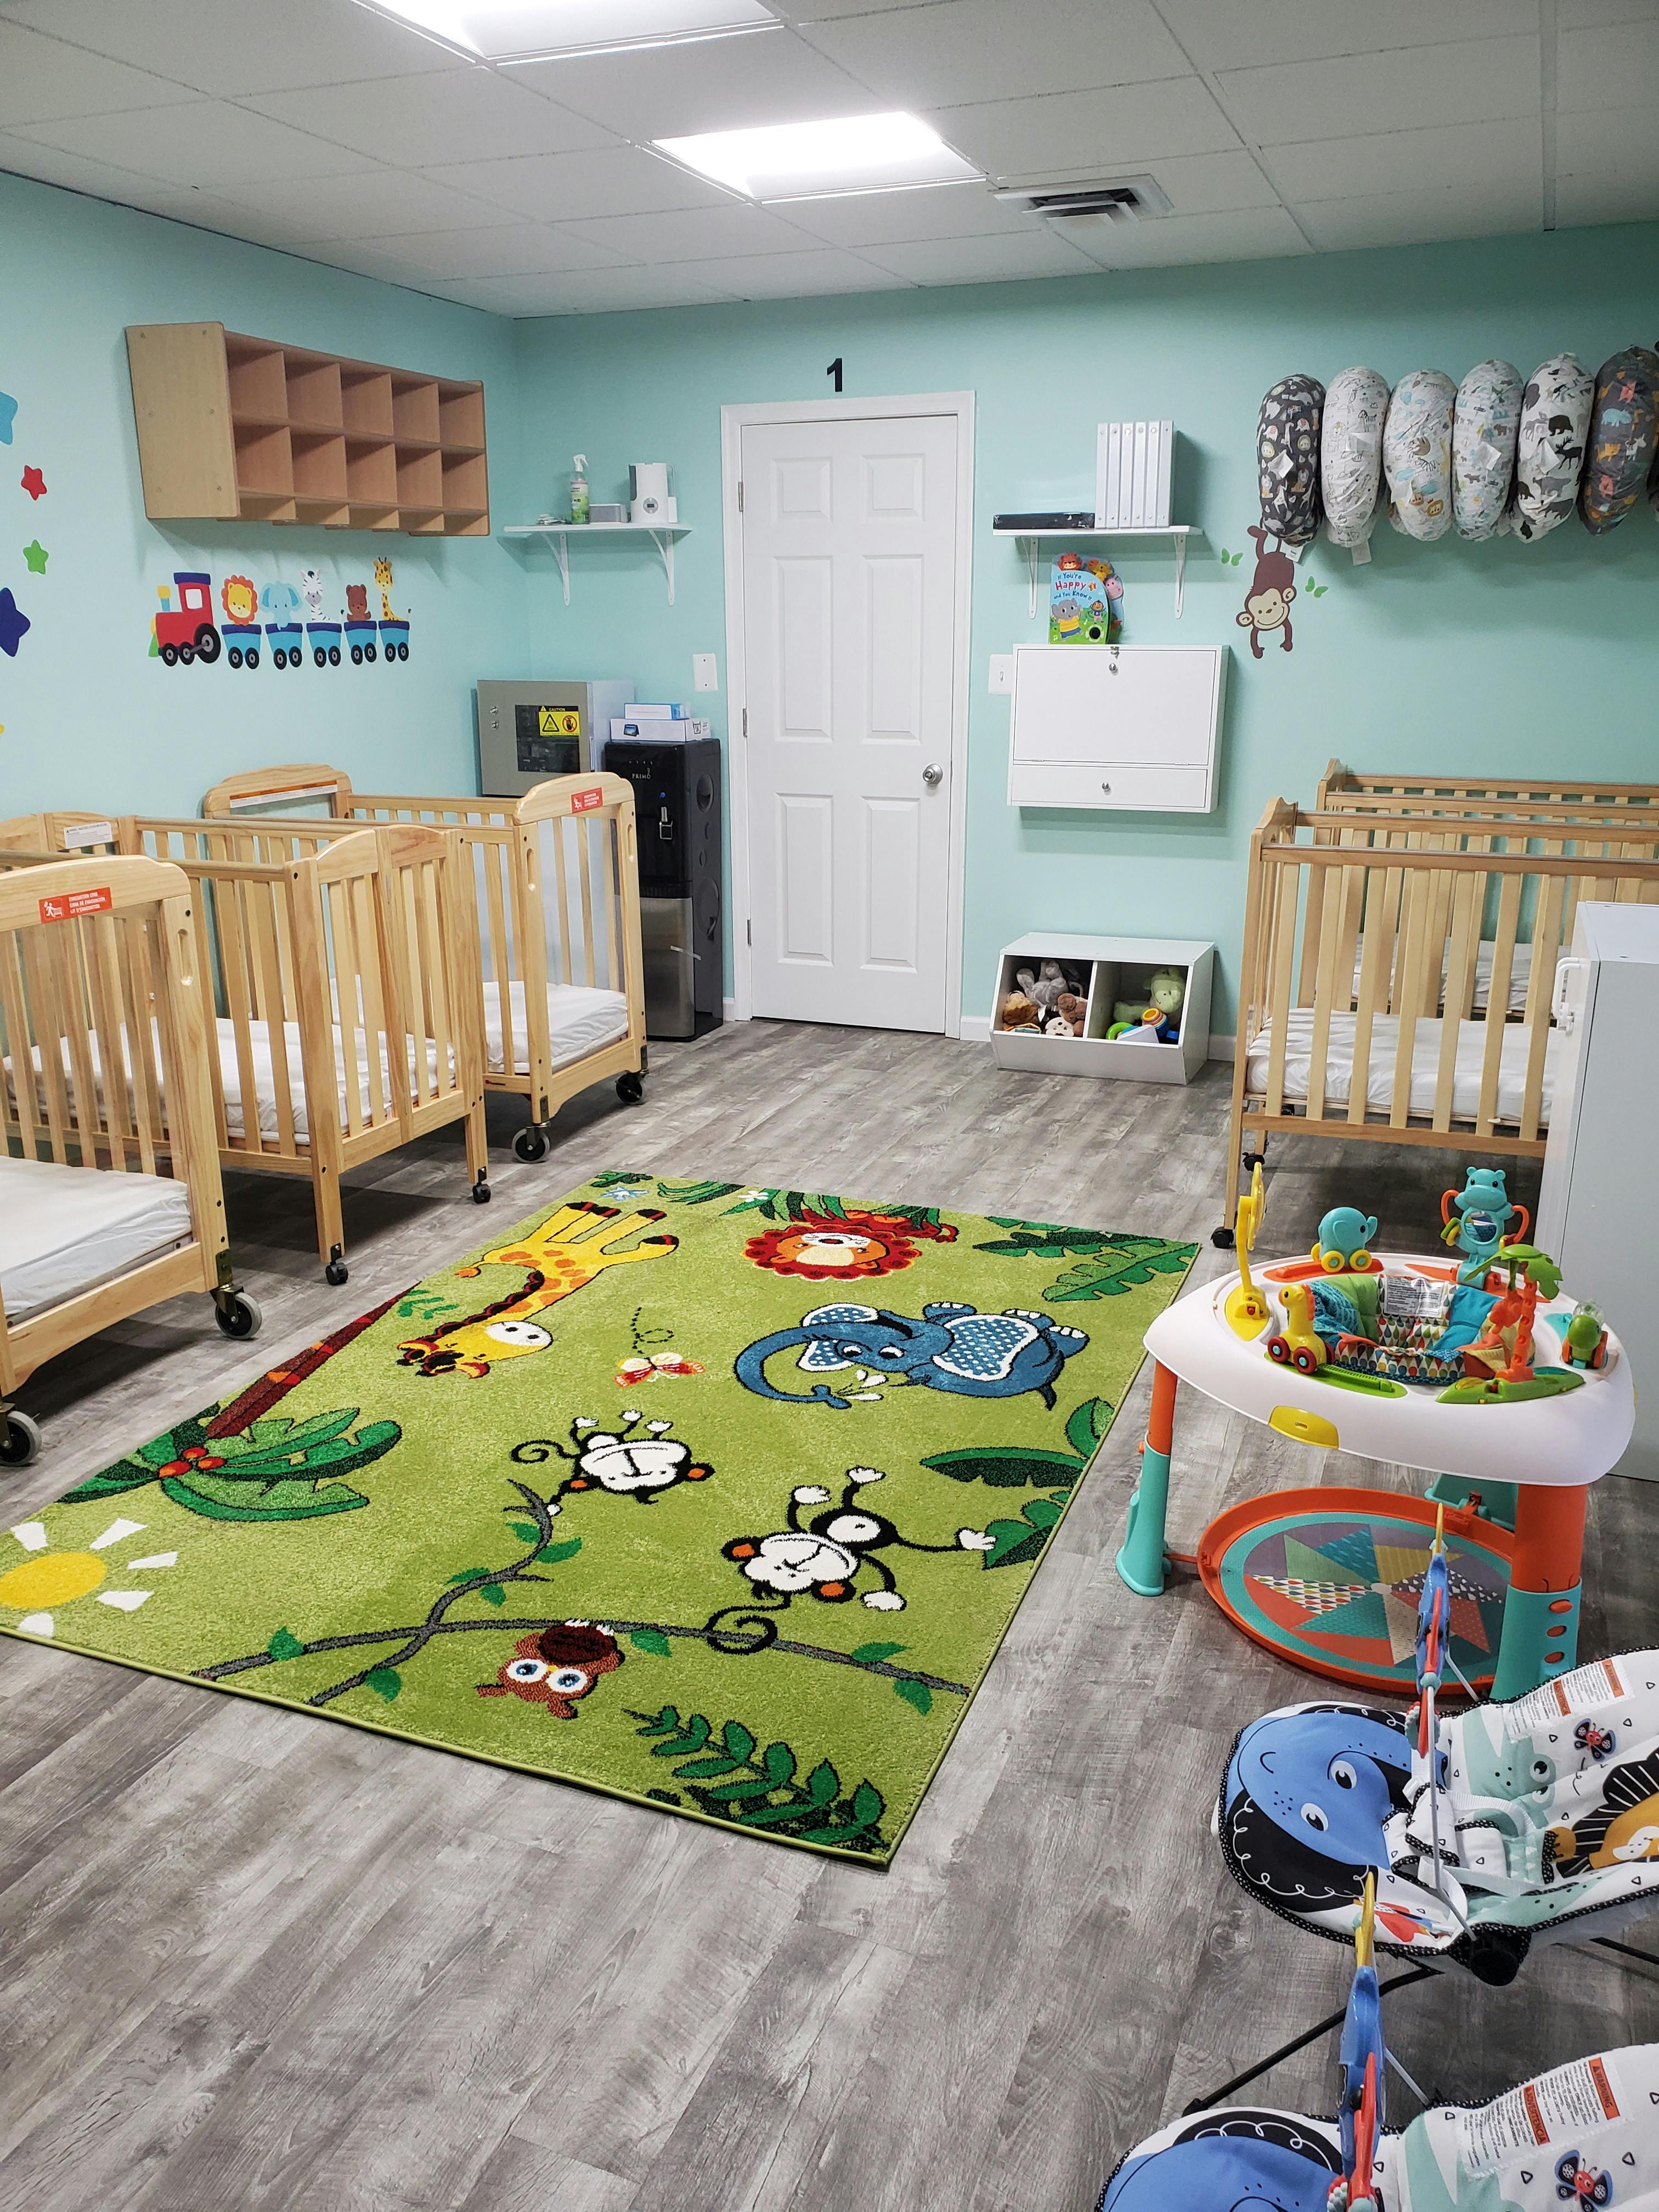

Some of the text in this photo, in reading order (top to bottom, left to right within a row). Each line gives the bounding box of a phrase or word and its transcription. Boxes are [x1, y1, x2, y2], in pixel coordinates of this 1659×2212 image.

[827, 358, 842, 392] 1
[1055, 580, 1086, 591] Happy
[1072, 590, 1087, 599] Know
[1595, 2071, 1613, 2108] WARNING
[1525, 2092, 1547, 2143] ADVERTENCIA
